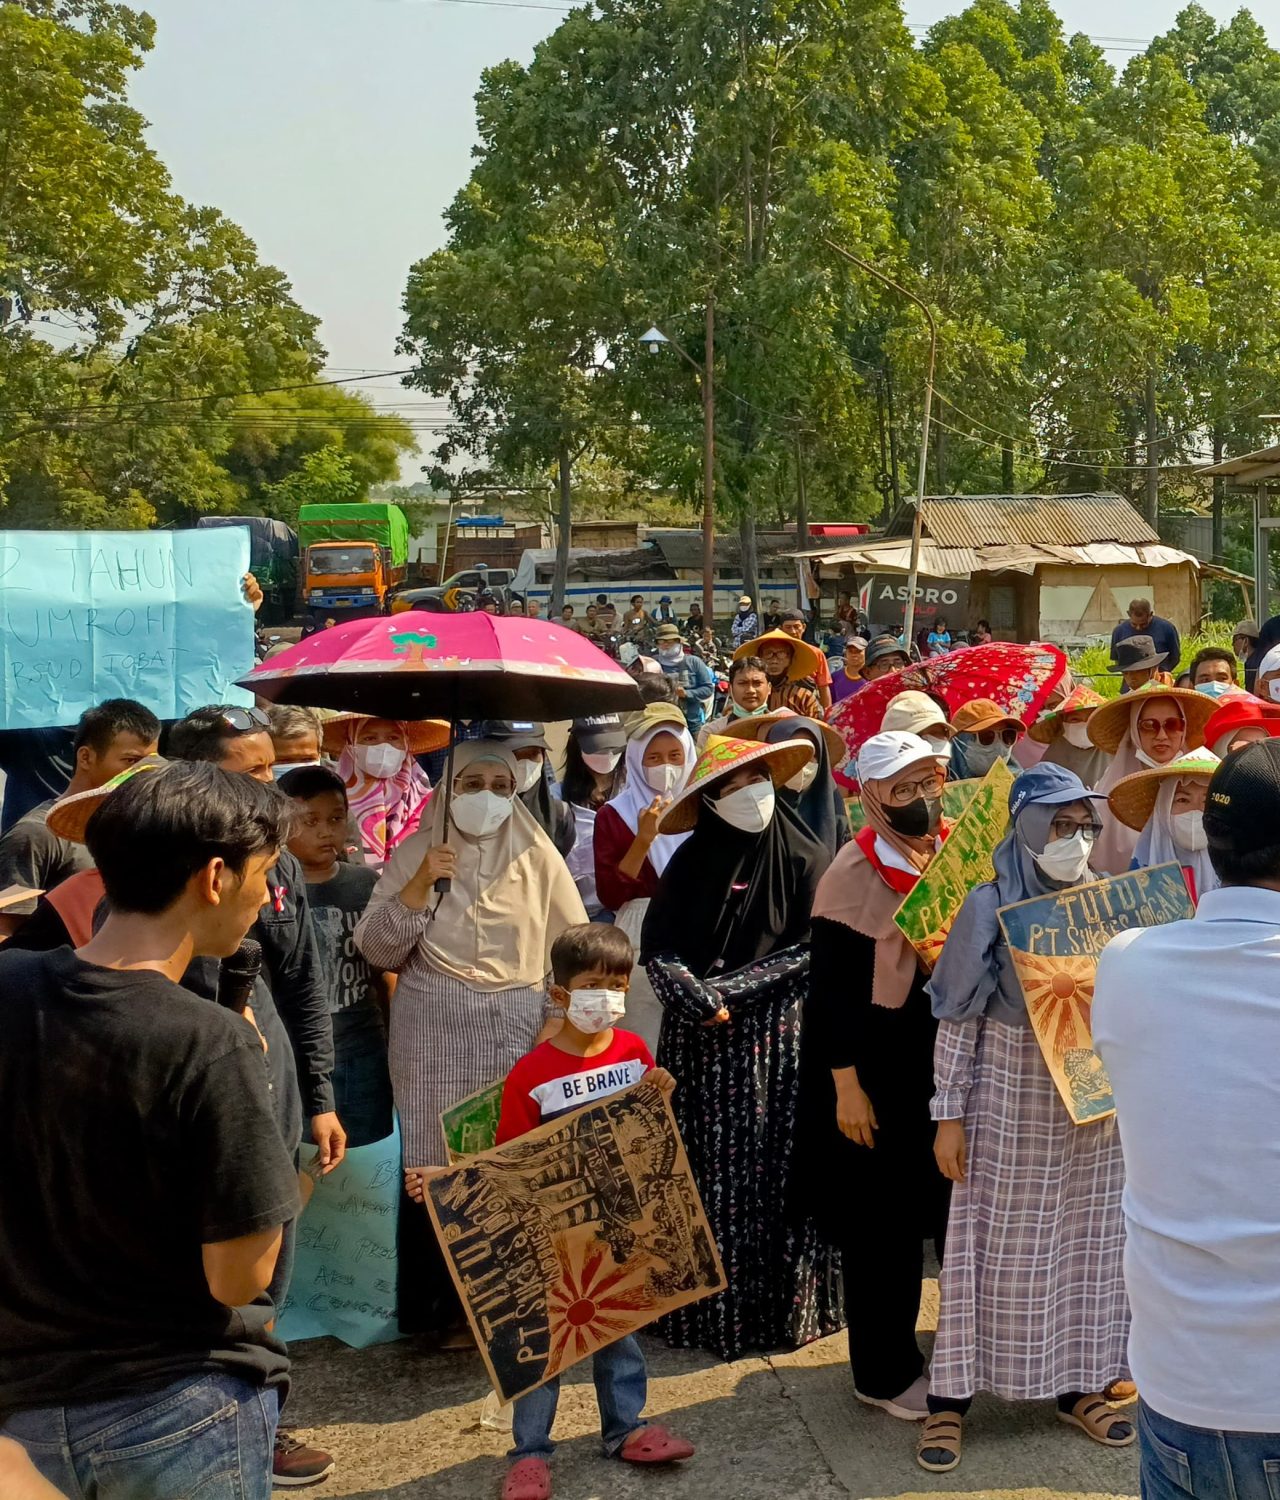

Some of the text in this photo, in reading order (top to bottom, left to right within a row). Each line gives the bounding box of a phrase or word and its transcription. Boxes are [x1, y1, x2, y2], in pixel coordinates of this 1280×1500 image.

[56, 547, 194, 592] TAHUN
[879, 584, 958, 605] ASPRO
[8, 605, 166, 648] UMROH
[10, 647, 190, 690] RSUD TOBAT
[1057, 872, 1150, 927] TUTUP
[562, 1067, 631, 1099] BE BRAVE
[443, 1220, 516, 1341] TUTUP
